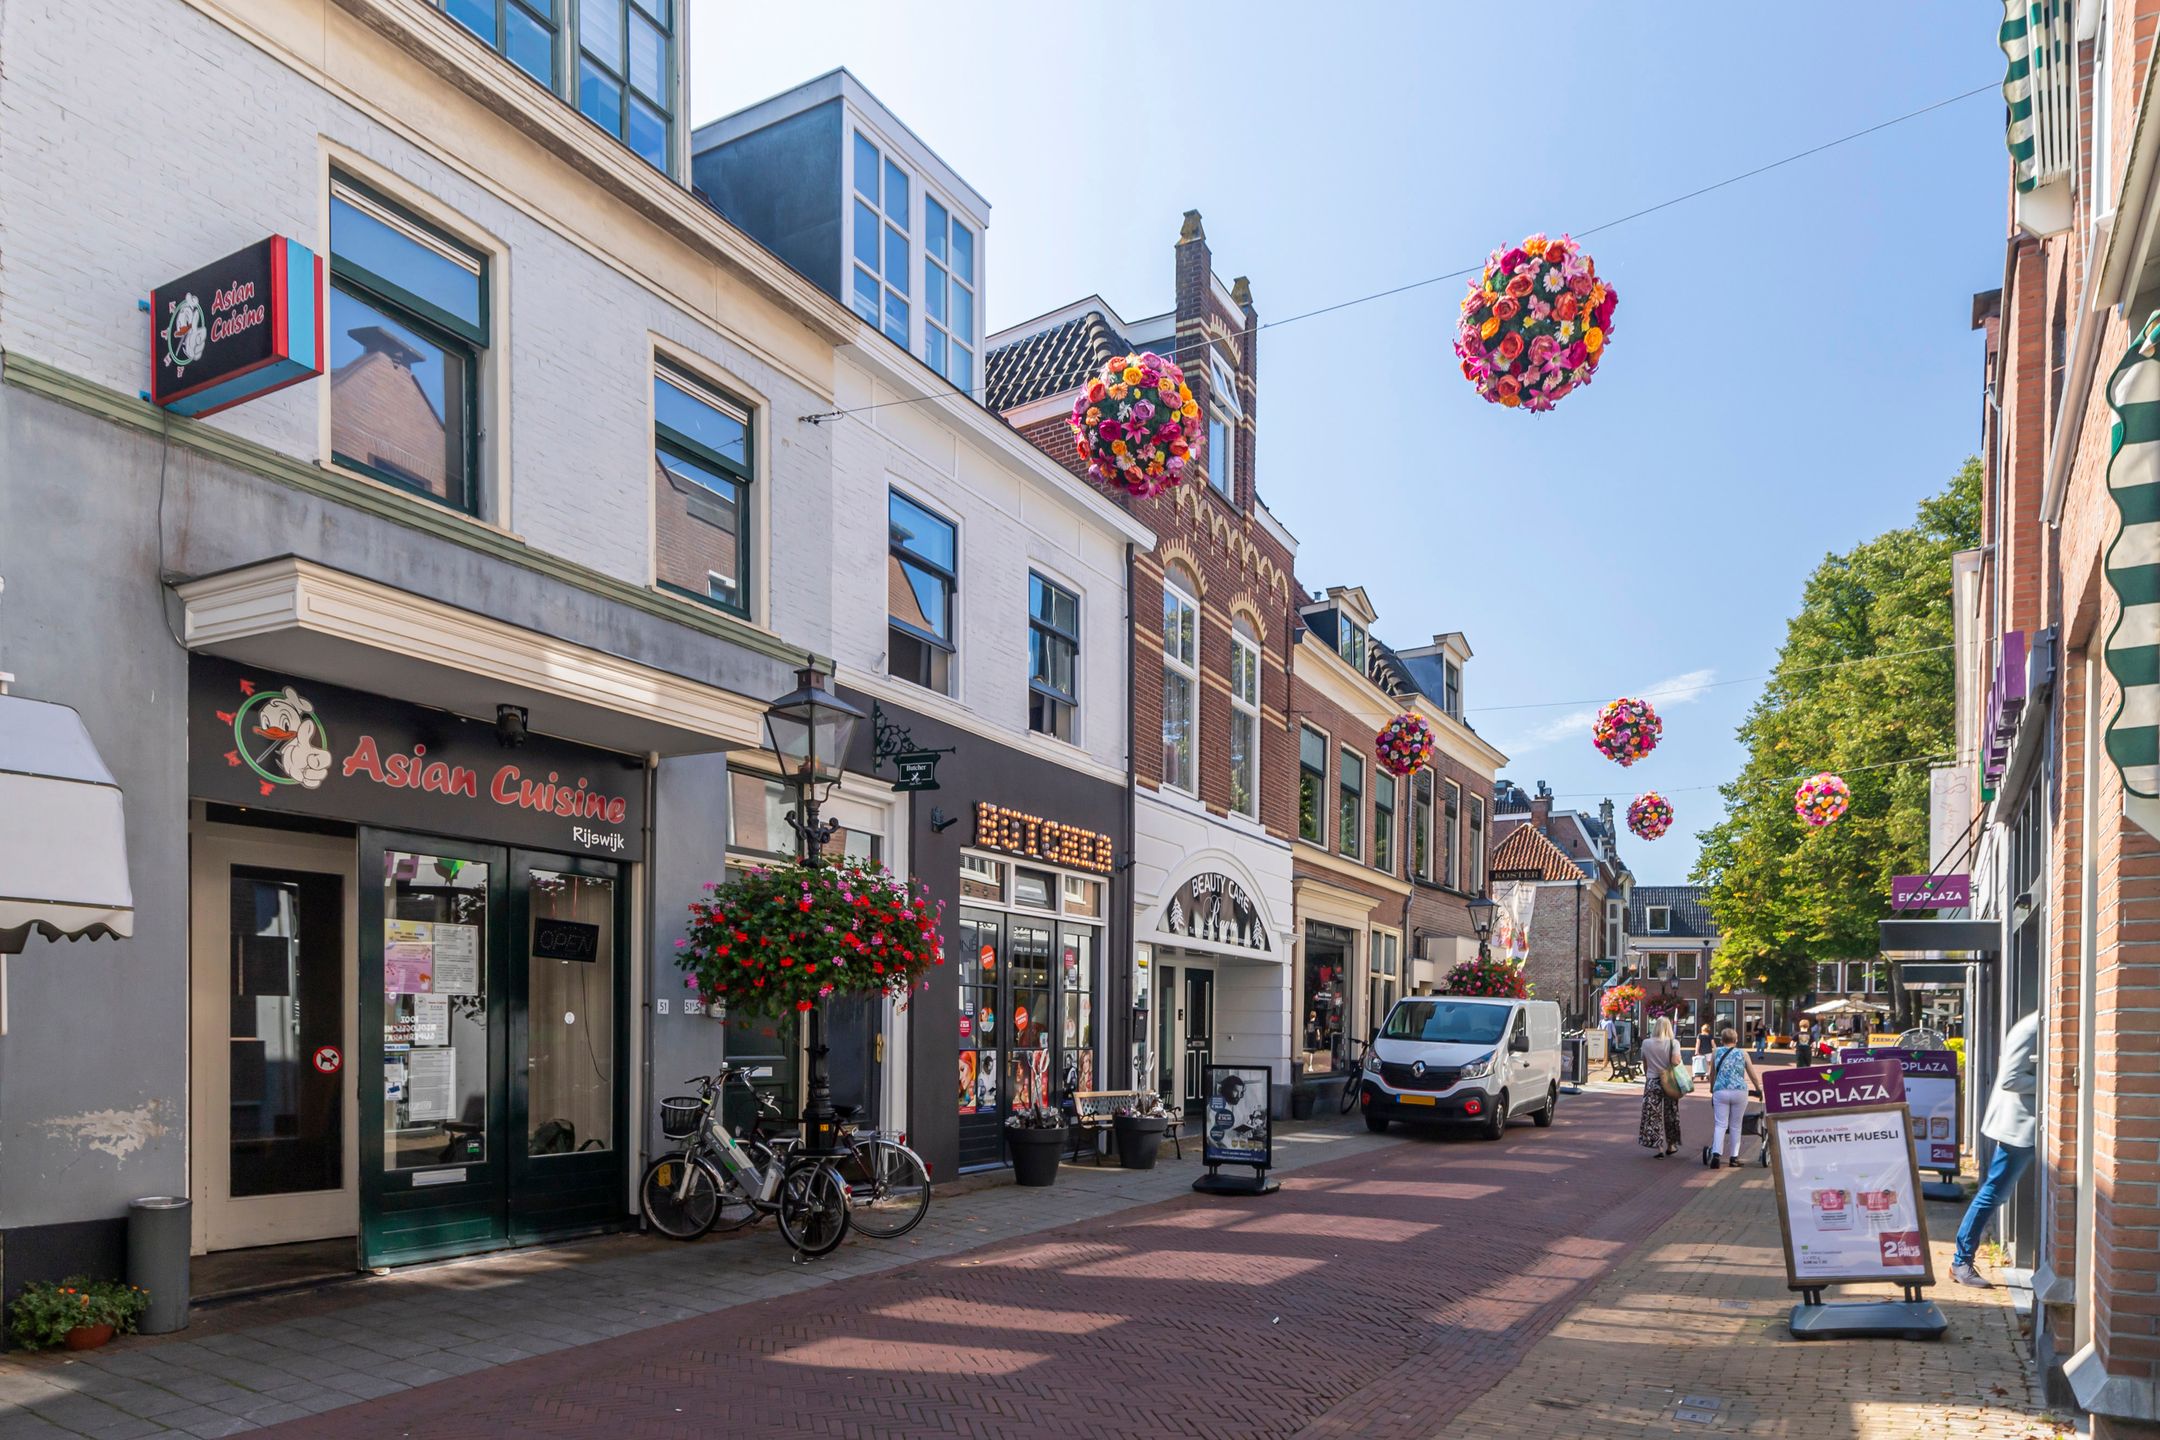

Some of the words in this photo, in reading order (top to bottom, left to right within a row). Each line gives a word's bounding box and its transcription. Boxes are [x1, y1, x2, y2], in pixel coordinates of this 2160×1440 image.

[212, 281, 254, 315] Asian
[211, 305, 265, 342] Cuisine
[342, 735, 477, 798] Asian
[490, 765, 626, 824] Cuisine
[573, 826, 625, 853] Rijswijk
[1495, 871, 1539, 880] KOSTER
[1191, 873, 1226, 898] BEAUTY
[1228, 880, 1250, 914] CARE
[1898, 891, 1962, 902] EKOPLAZA
[540, 929, 595, 951] OPEN
[660, 1002, 667, 1011] 51
[1901, 1062, 1949, 1072] OPLAZA
[1780, 1085, 1889, 1107] EKOPLAZA
[1788, 1133, 1852, 1145] KROKANTE
[1854, 1130, 1899, 1141] MUESLI
